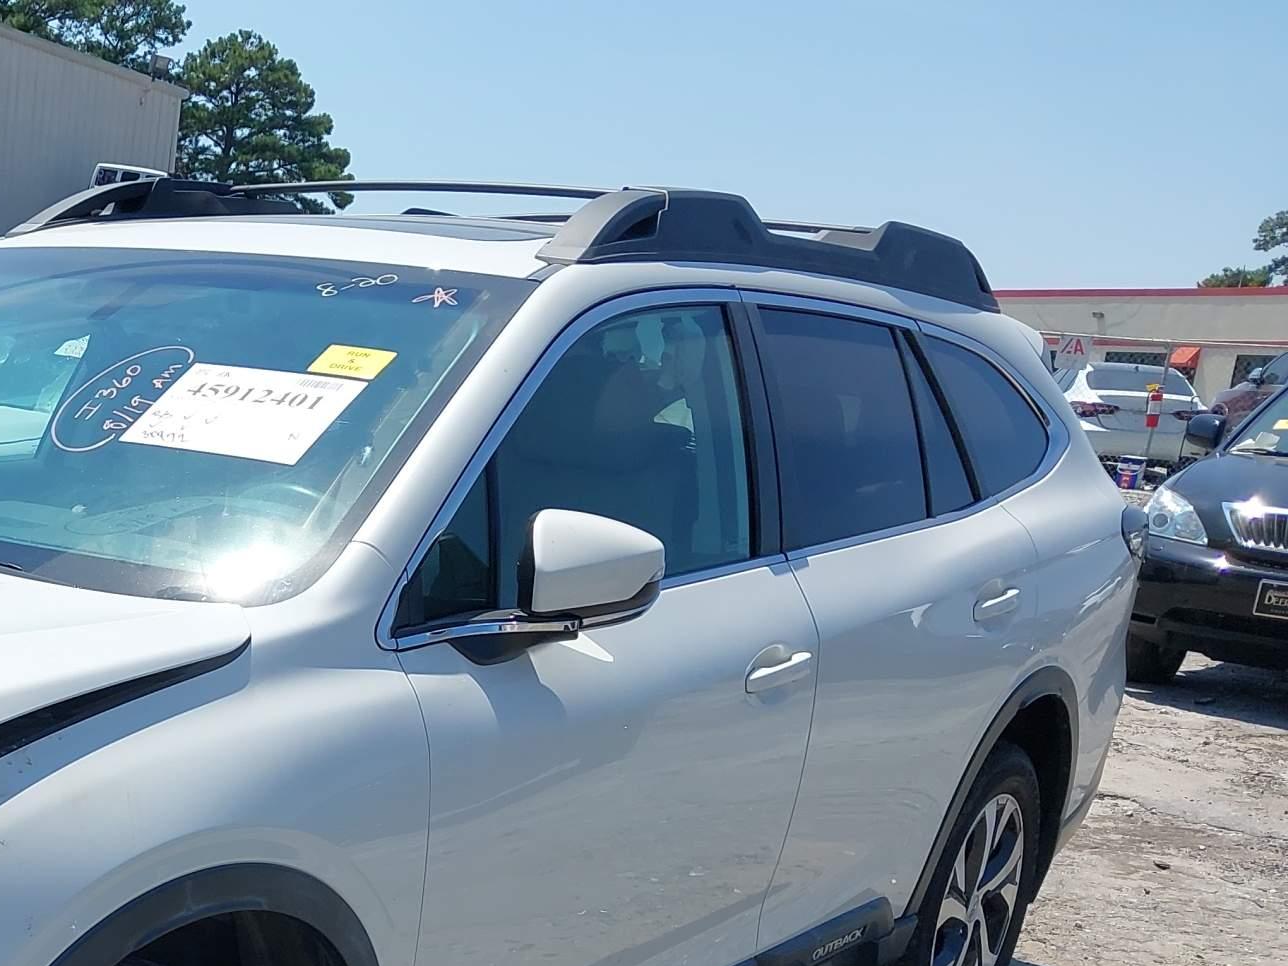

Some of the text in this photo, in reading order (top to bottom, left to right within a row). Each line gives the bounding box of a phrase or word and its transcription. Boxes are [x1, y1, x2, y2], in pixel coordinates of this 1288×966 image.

[316, 274, 399, 297] 8-20
[347, 351, 371, 359] RUN
[329, 363, 363, 372] DRIVE
[186, 381, 325, 411] 45912401
[812, 927, 864, 960] OUTBACK
